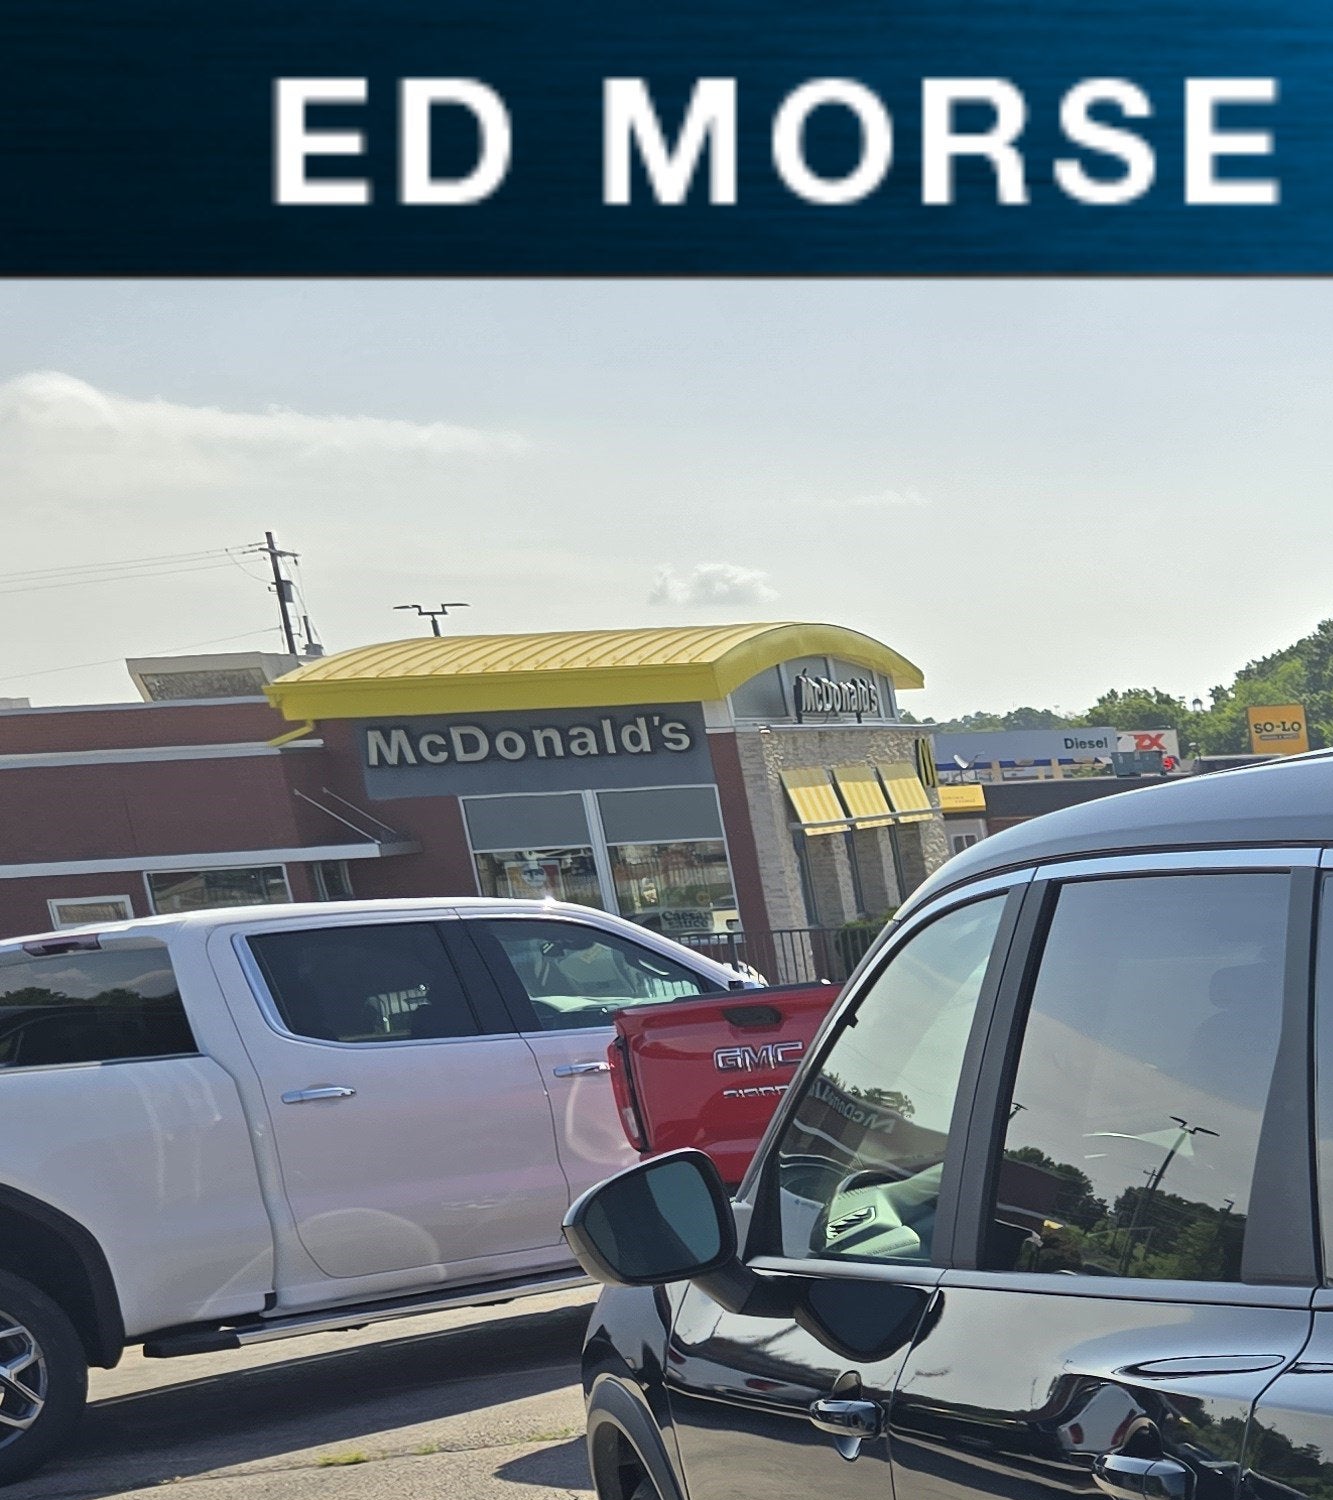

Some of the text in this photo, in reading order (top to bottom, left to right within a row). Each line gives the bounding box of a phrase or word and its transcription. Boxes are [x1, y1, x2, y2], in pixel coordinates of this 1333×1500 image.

[799, 672, 879, 713] McDonald's
[366, 715, 693, 768] McDonald's
[1064, 737, 1108, 750] Diesel
[1253, 721, 1302, 734] SO-LO
[714, 1041, 803, 1073] GMC
